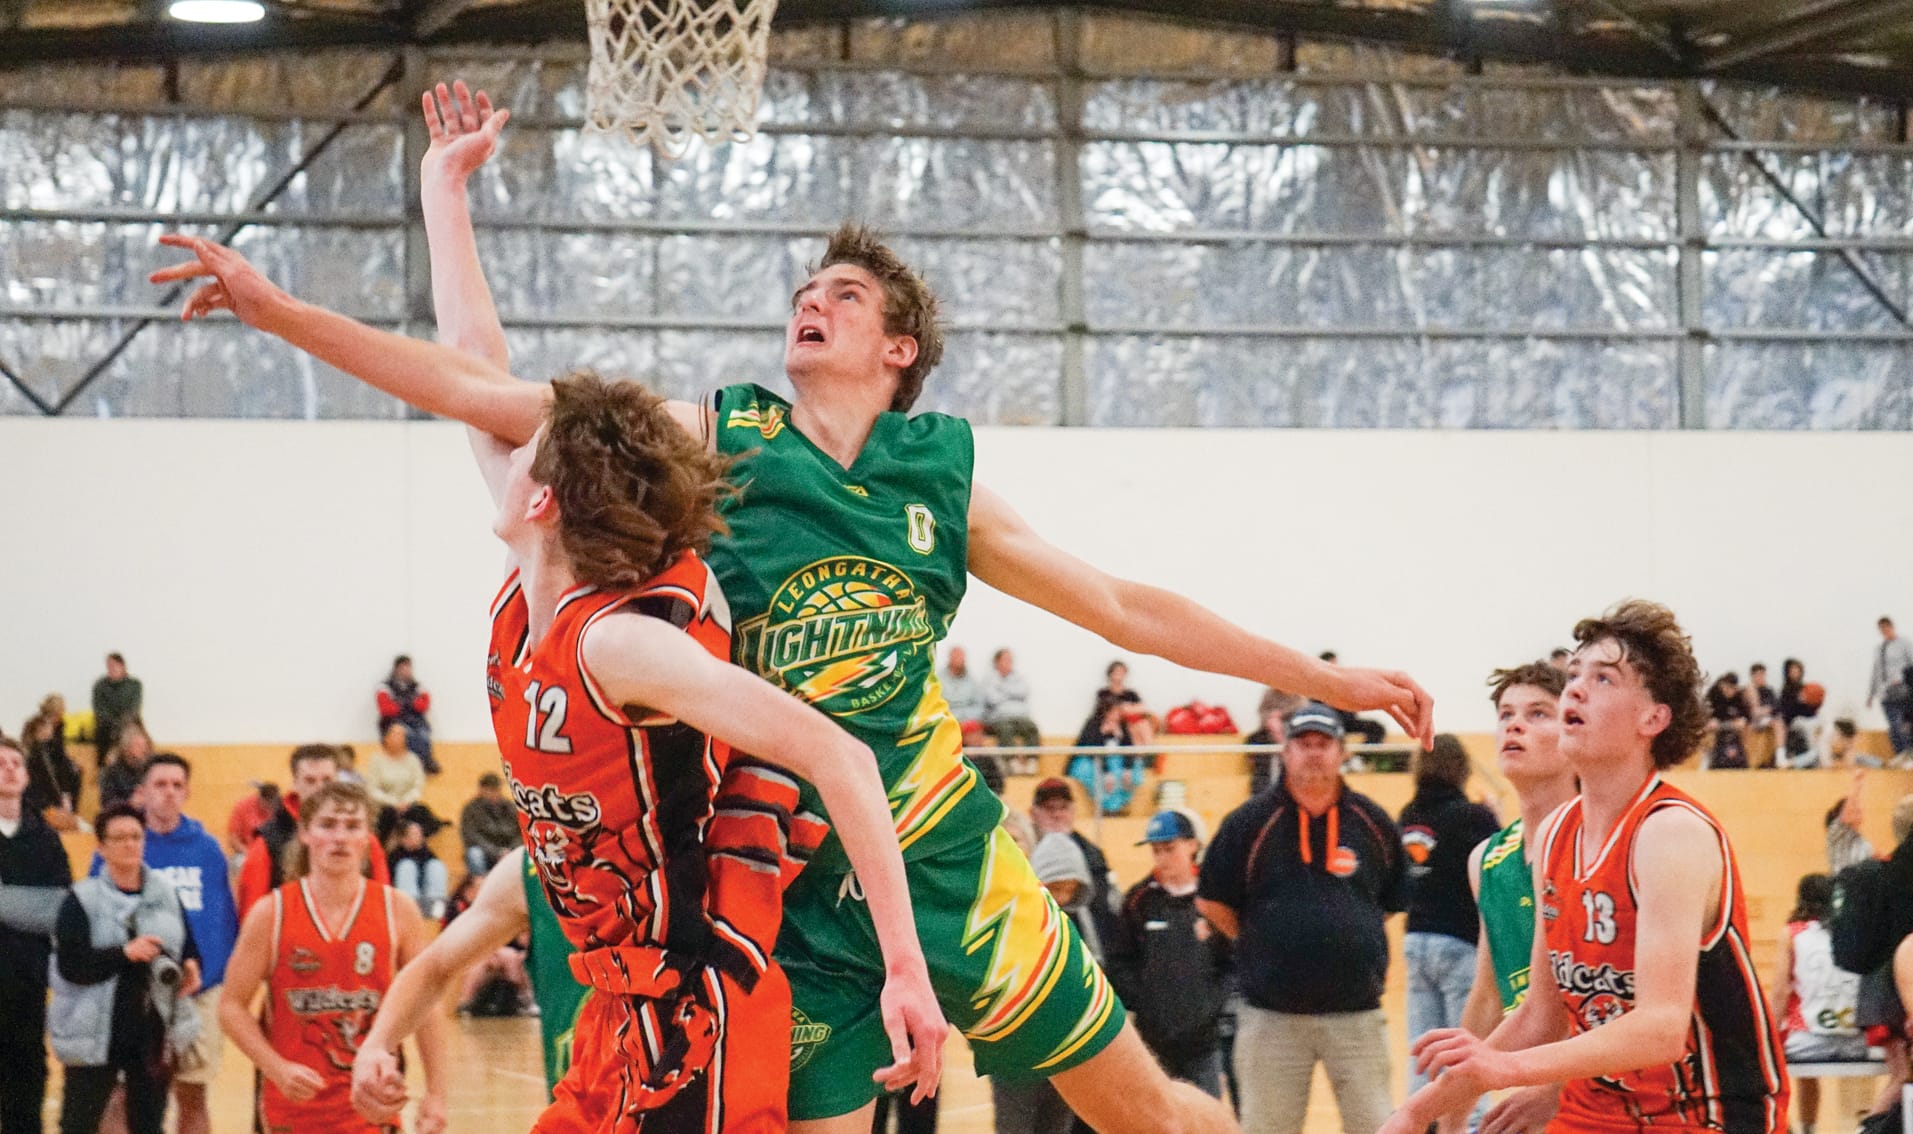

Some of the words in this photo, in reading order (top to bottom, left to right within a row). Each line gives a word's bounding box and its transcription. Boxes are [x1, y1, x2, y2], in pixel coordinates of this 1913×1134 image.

[777, 561, 912, 614] LEONGATHA
[523, 679, 574, 755] 12
[511, 781, 601, 832] cats
[1582, 888, 1618, 946] 13
[354, 941, 375, 976] 8
[1549, 950, 1635, 998] ldcats
